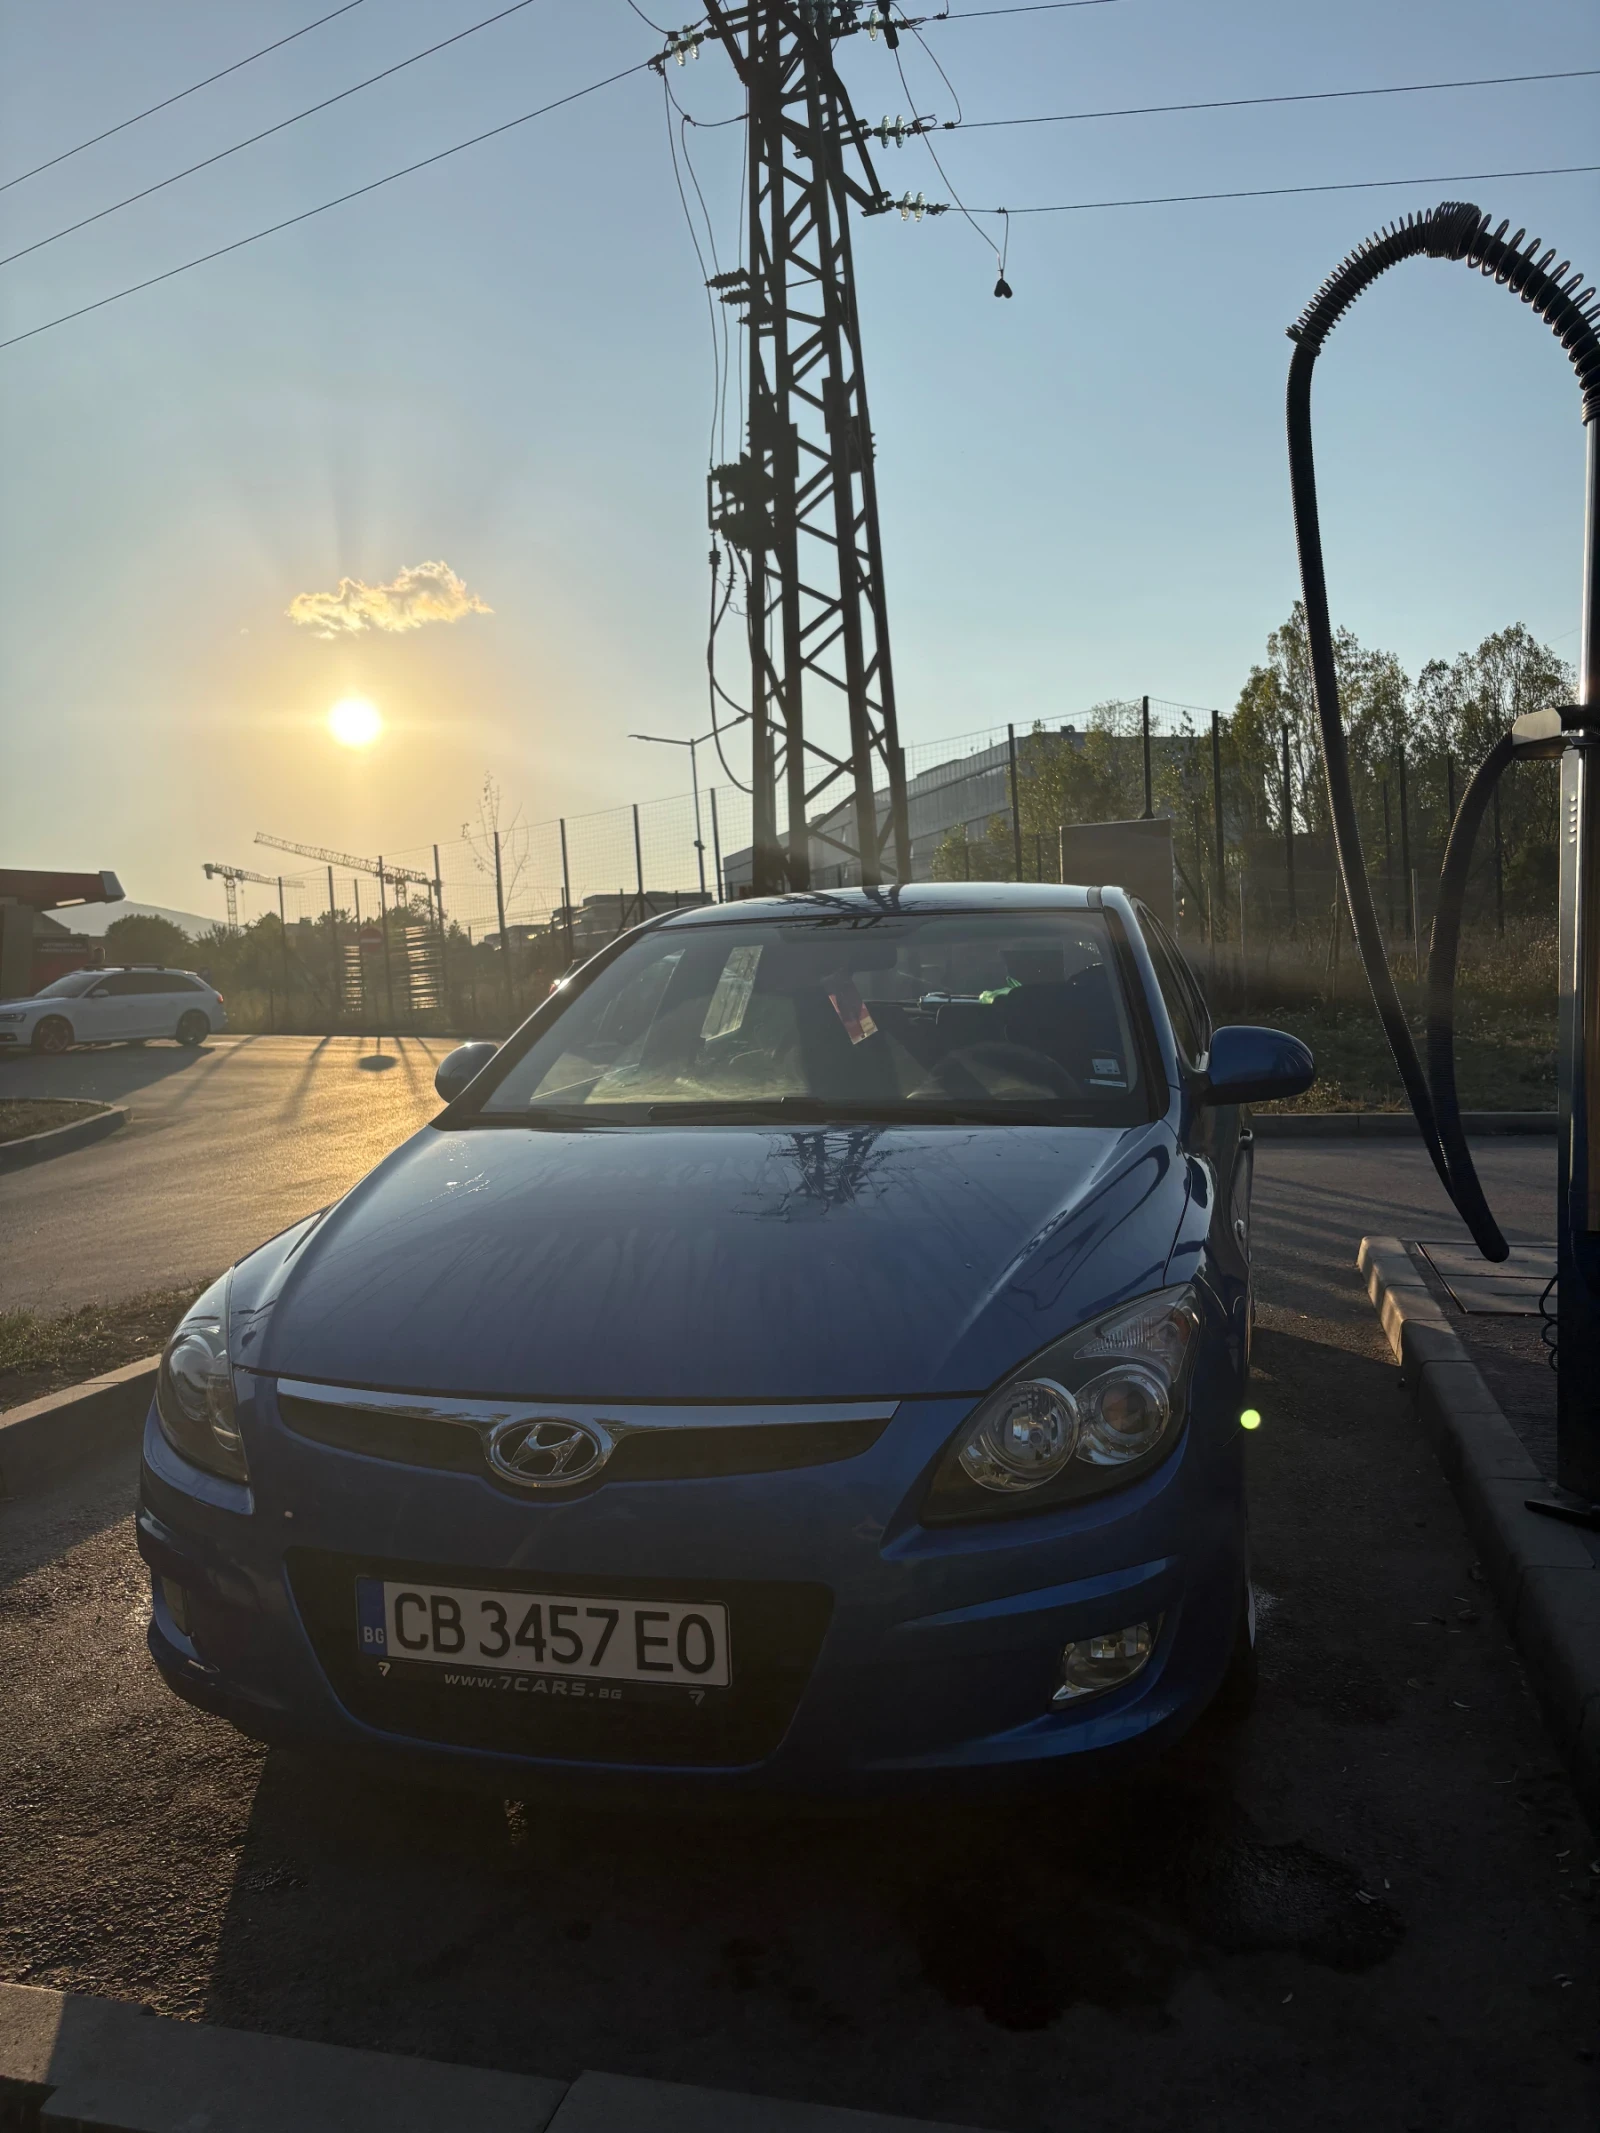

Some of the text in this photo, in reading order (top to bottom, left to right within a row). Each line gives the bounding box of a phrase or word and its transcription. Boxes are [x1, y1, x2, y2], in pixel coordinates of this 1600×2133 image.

[363, 1625, 386, 1645] BG
[394, 1592, 716, 1675] CB 3457 EO
